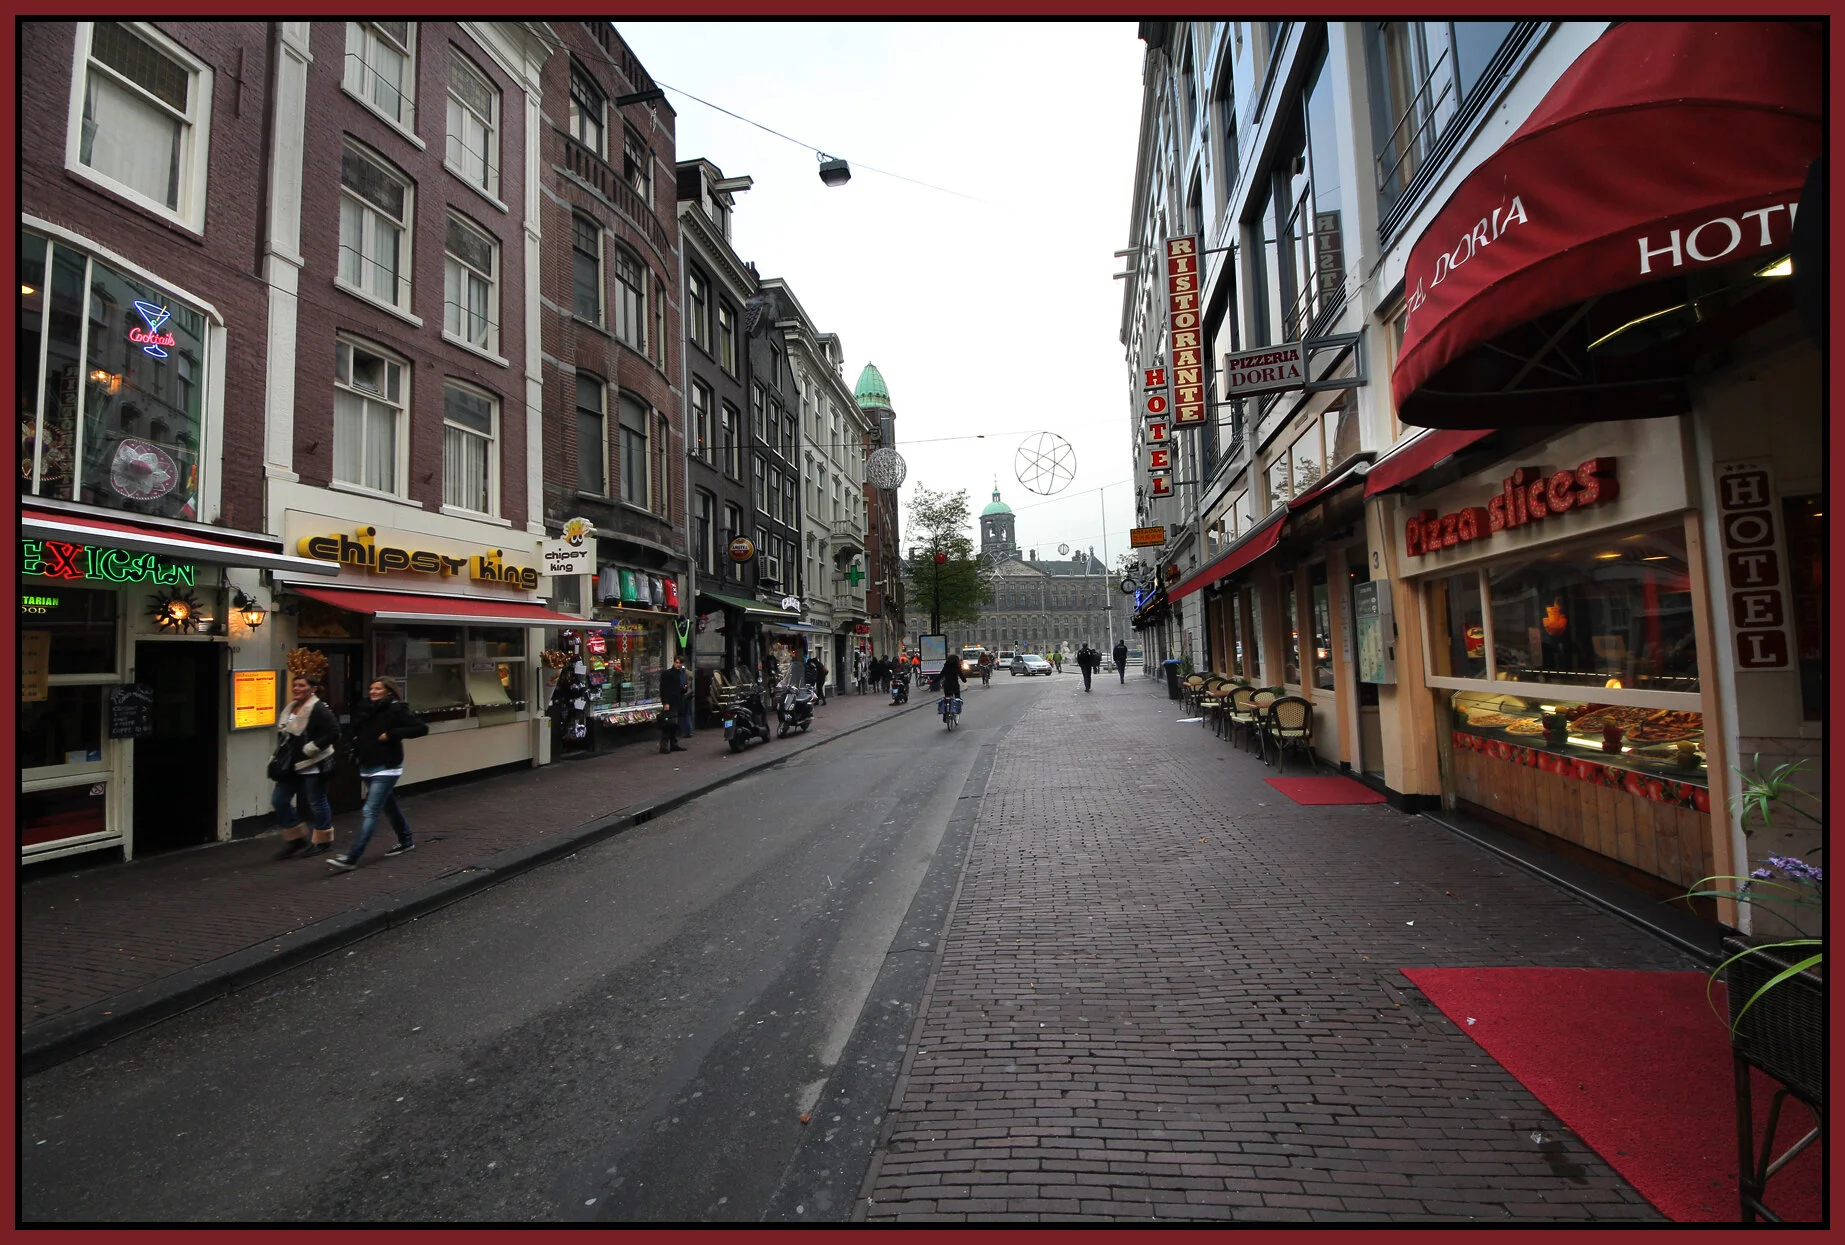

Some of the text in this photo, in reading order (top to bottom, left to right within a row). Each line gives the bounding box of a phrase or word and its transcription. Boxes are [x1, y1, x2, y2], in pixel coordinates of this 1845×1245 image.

[1430, 195, 1528, 289] DORIA
[1638, 203, 1799, 275] HOT
[129, 327, 175, 346] Cocktails
[1171, 240, 1199, 421] RISTORANTE
[1230, 349, 1299, 370] PIZZERIA
[1231, 364, 1301, 387] DORIA
[1145, 369, 1169, 494] HOTEL
[1406, 457, 1614, 557] Pizza slices
[472, 549, 539, 590] king
[550, 560, 573, 572] king
[1372, 551, 1380, 570] 3
[1727, 476, 1776, 662] HOTEL
